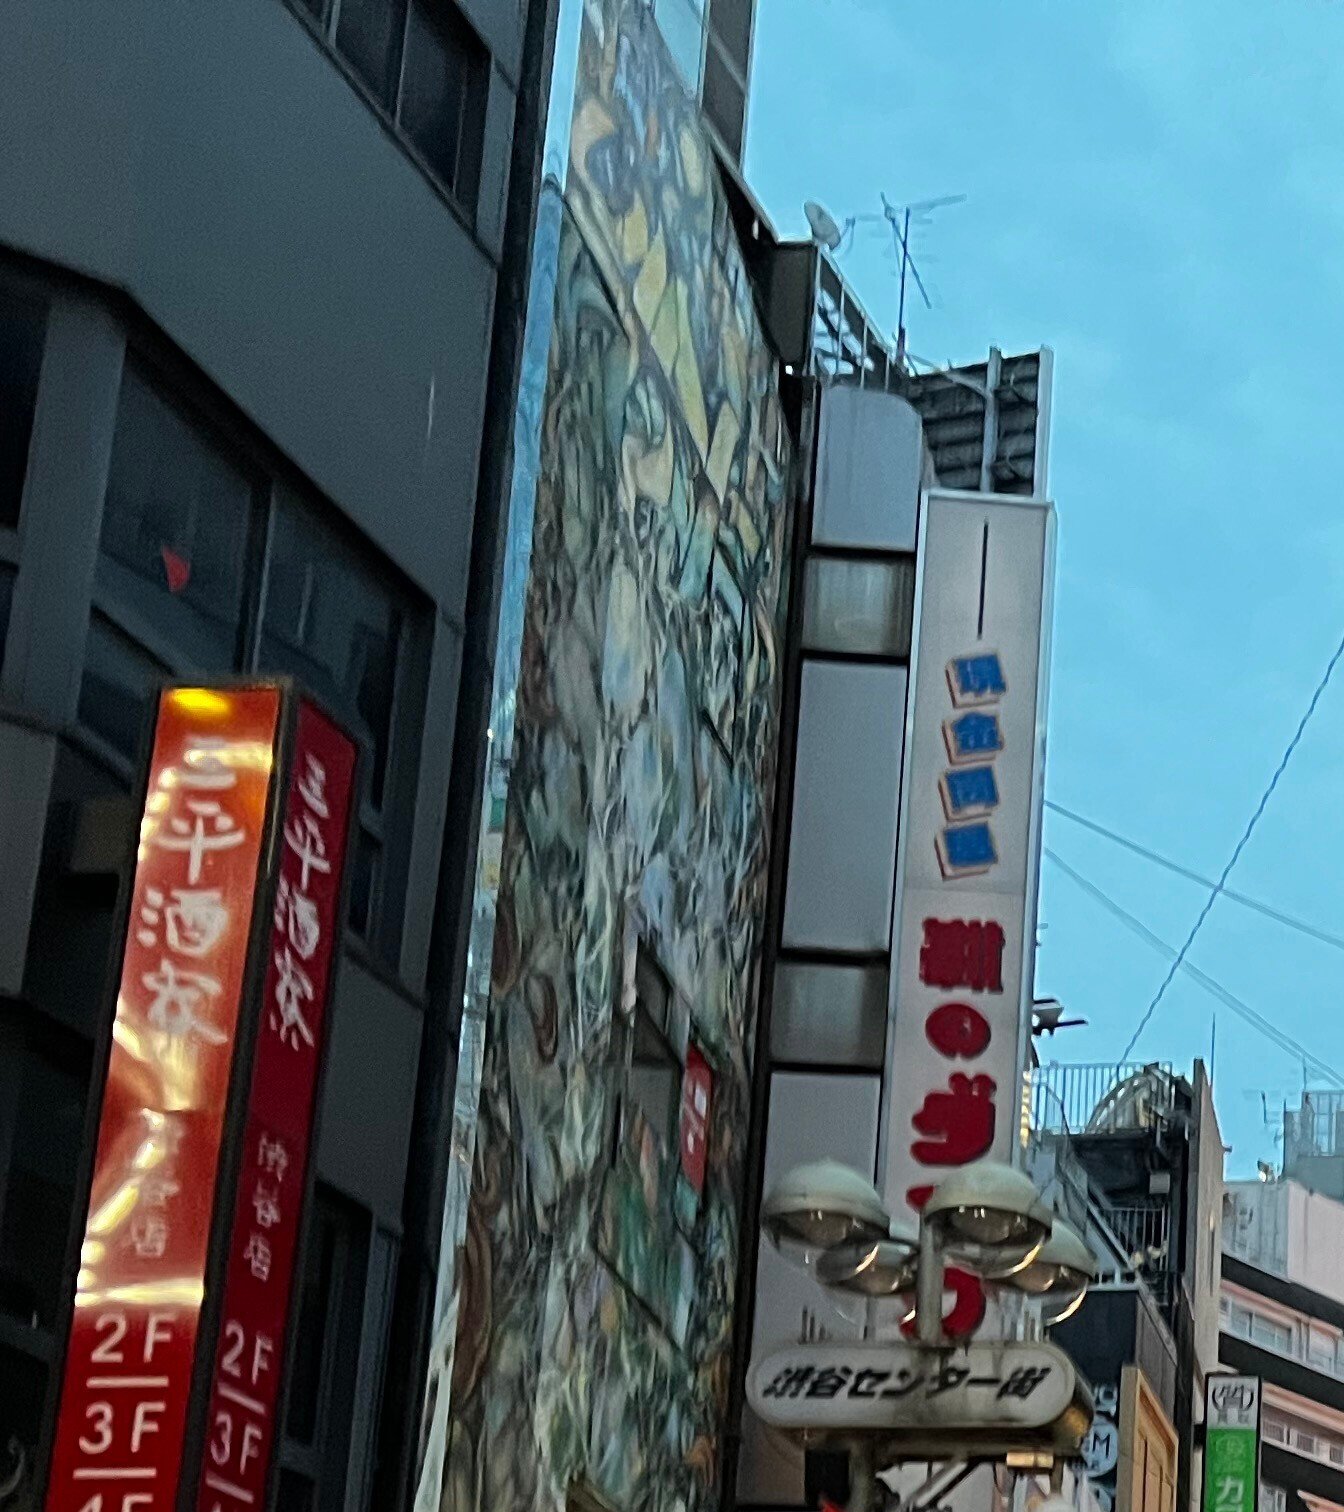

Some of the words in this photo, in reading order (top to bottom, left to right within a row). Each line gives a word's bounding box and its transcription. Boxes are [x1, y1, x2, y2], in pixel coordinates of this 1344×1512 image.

[91, 1312, 177, 1364] 2F
[221, 1319, 274, 1386] 2F
[762, 1365, 1052, 1401] 渋谷センター街
[79, 1402, 167, 1455] 3F
[210, 1411, 263, 1476] 3F
